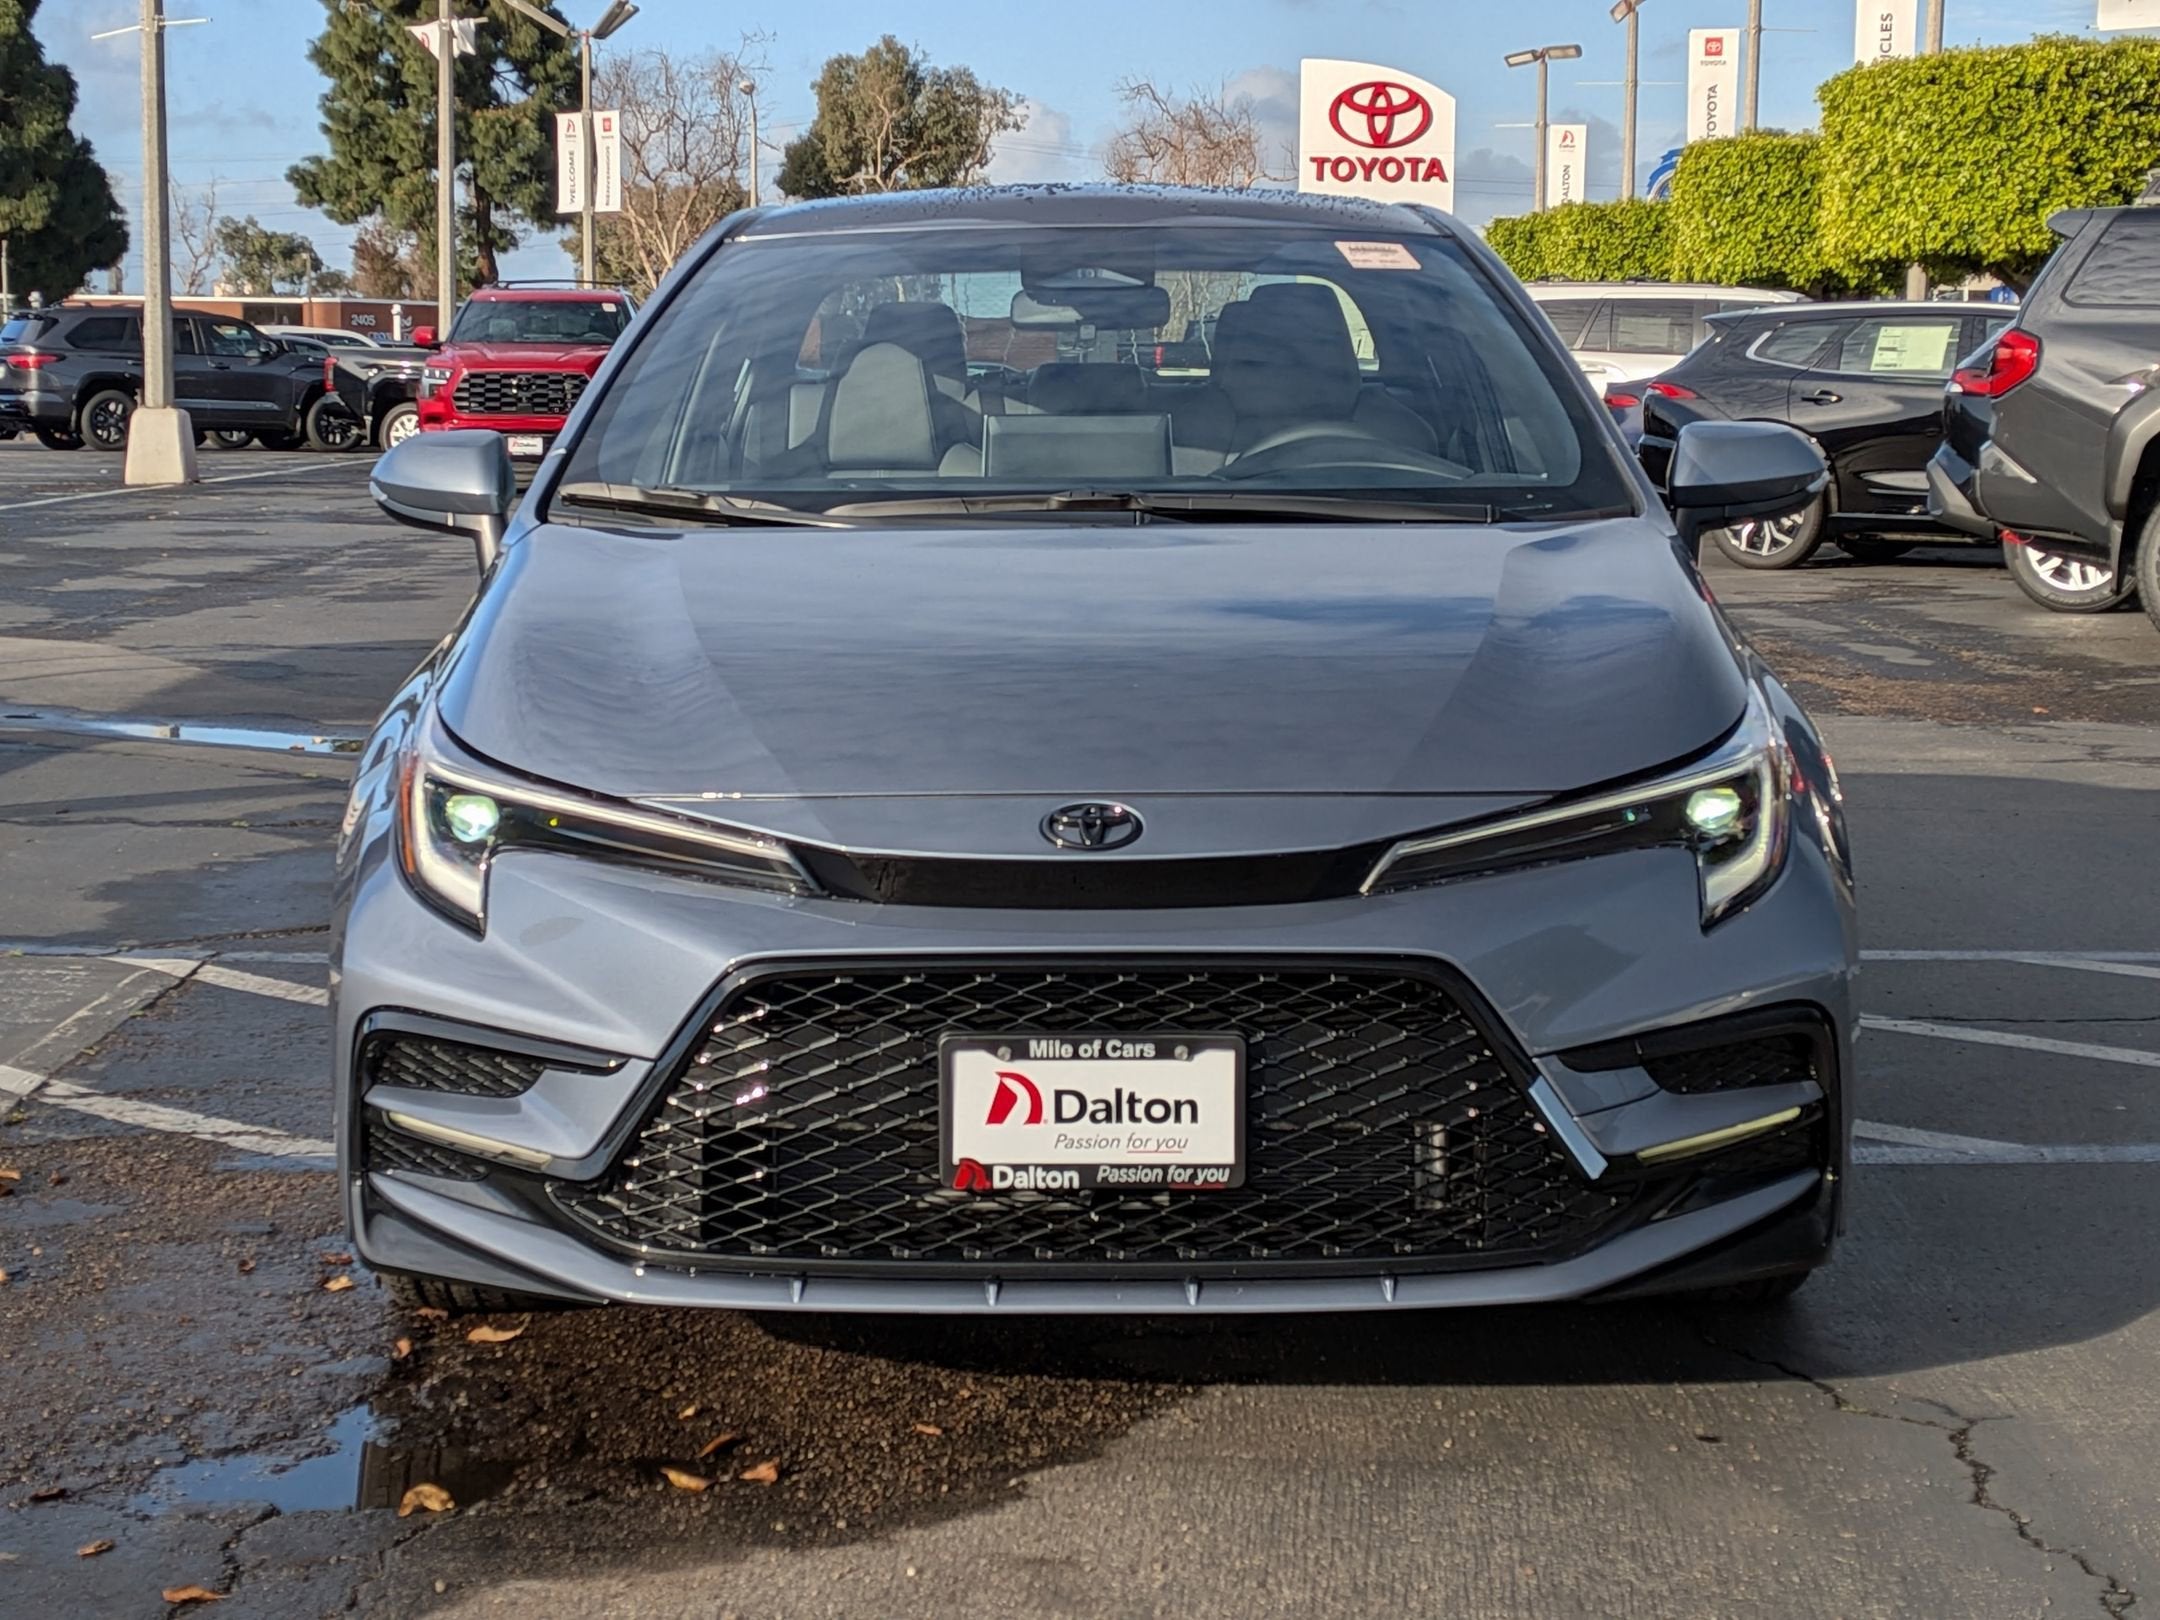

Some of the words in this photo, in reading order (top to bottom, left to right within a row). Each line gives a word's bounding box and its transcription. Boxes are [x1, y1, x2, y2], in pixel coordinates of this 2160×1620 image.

[1880, 13, 1893, 58] ICLES
[568, 150, 577, 205] WELCOME
[1309, 156, 1449, 183] TOYOTA
[351, 314, 376, 326] 2405
[1029, 1039, 1074, 1058] Mile
[1078, 1039, 1102, 1059] of
[1105, 1039, 1156, 1059] Cars
[1053, 1087, 1198, 1125] Dalton
[1054, 1133, 1120, 1149] Passion
[1124, 1132, 1151, 1150] for
[1155, 1137, 1188, 1151] you
[992, 1165, 1080, 1190] Dalton
[1096, 1165, 1163, 1183] Passion
[1166, 1165, 1196, 1184] for
[1195, 1168, 1230, 1186] you
